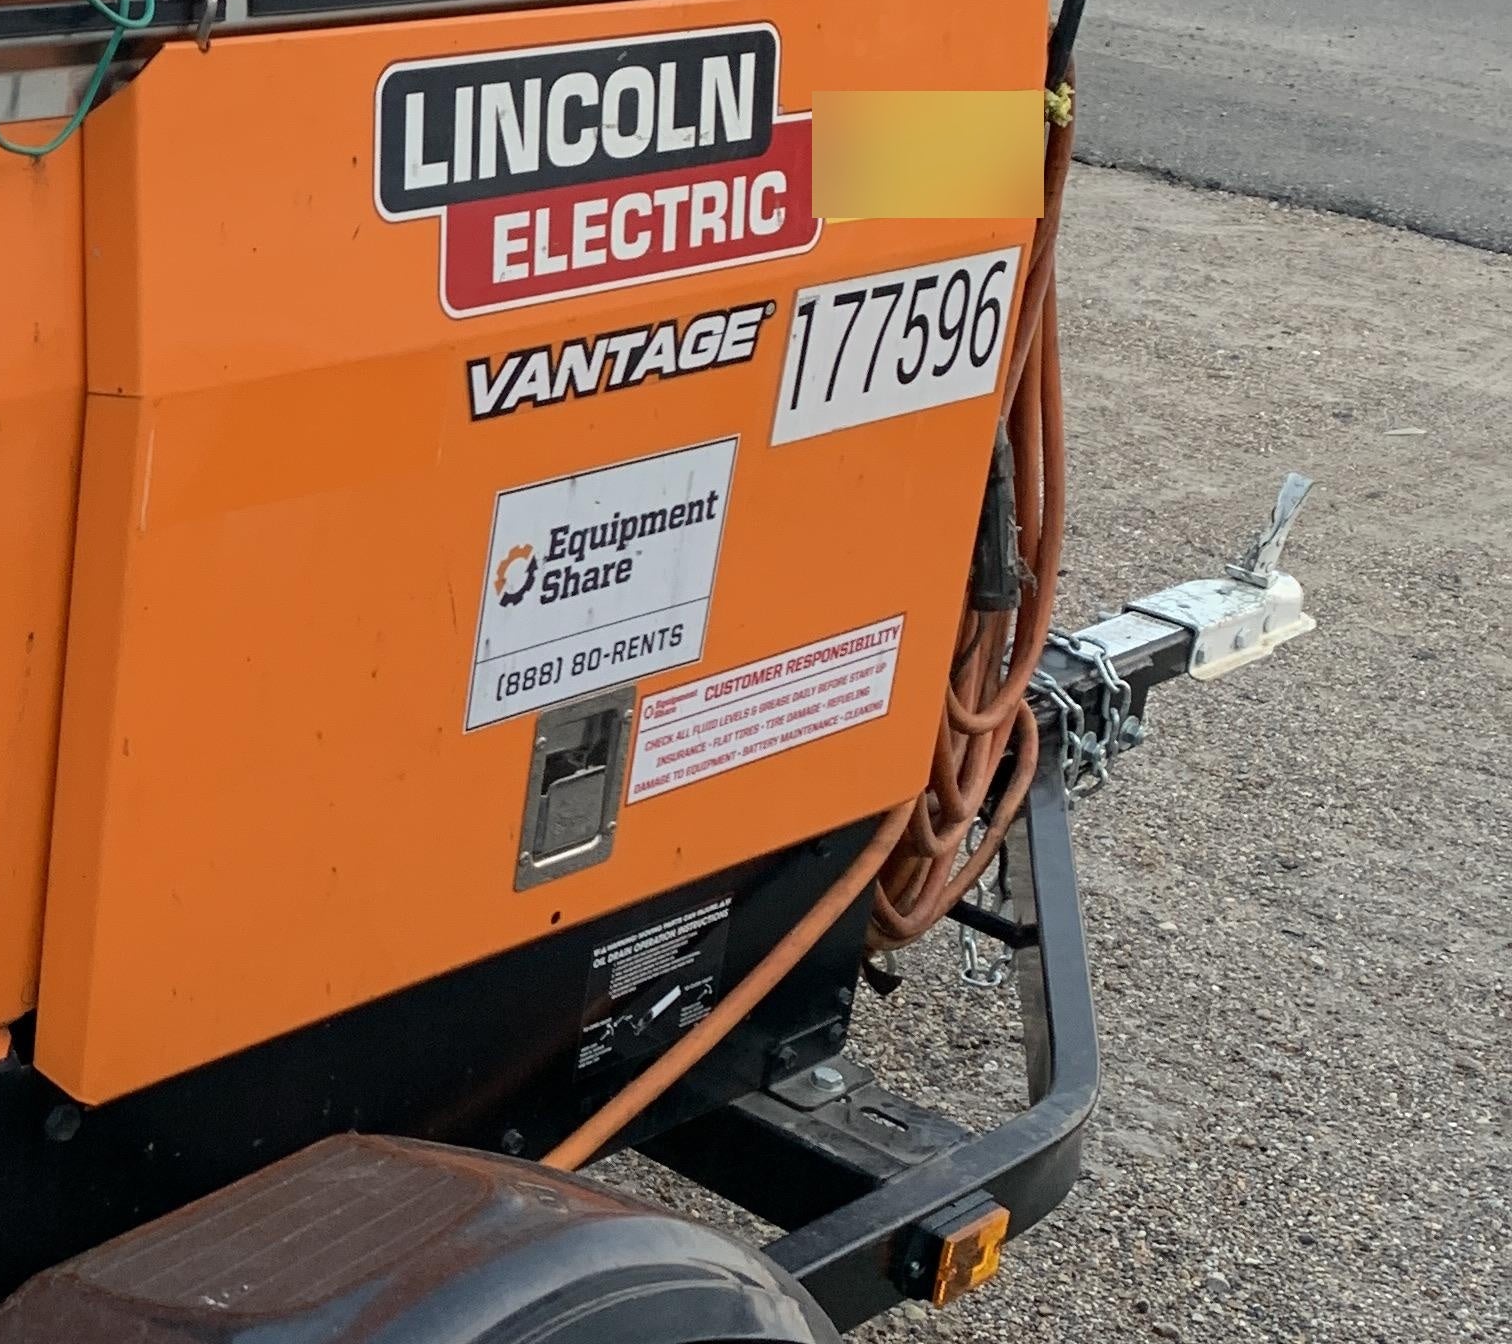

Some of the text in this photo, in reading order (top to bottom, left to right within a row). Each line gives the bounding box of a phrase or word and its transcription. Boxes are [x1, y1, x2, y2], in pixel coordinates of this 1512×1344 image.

[403, 52, 756, 191] LINCOLN
[491, 170, 787, 284] ELECTRIC
[469, 303, 766, 421] VANTAGE
[789, 259, 1007, 411] 177596
[547, 489, 720, 563] Equipment
[539, 558, 633, 606] Share
[495, 624, 685, 701] (888) 80-RENTS
[704, 624, 901, 702] CUSTOMER RESPONSIBILITY
[633, 772, 671, 795] DAMAGE
[673, 768, 685, 781] TO
[685, 750, 737, 776] EQUIPMENT
[742, 735, 780, 757] BATTERY
[779, 714, 840, 744] MAINTENANCE
[843, 699, 885, 721] CLEANING
[644, 734, 674, 752] CHECK
[676, 728, 690, 740] ALL
[692, 719, 719, 735] FLUID
[719, 708, 750, 727] LEVELS
[758, 694, 791, 714] GREASE
[792, 686, 817, 703] DAILY
[817, 676, 848, 694] BEFORE
[849, 665, 876, 683] START
[875, 661, 888, 675] UP
[656, 742, 707, 768] INSURANCE
[712, 732, 733, 748] FLAT
[734, 724, 760, 741] TIRES
[765, 715, 785, 730] TIRE
[786, 702, 823, 723] DAMAGE
[826, 686, 871, 709] REFUELING
[633, 928, 677, 953] OPERATION
[677, 908, 730, 936] INSTRUCTIONS
